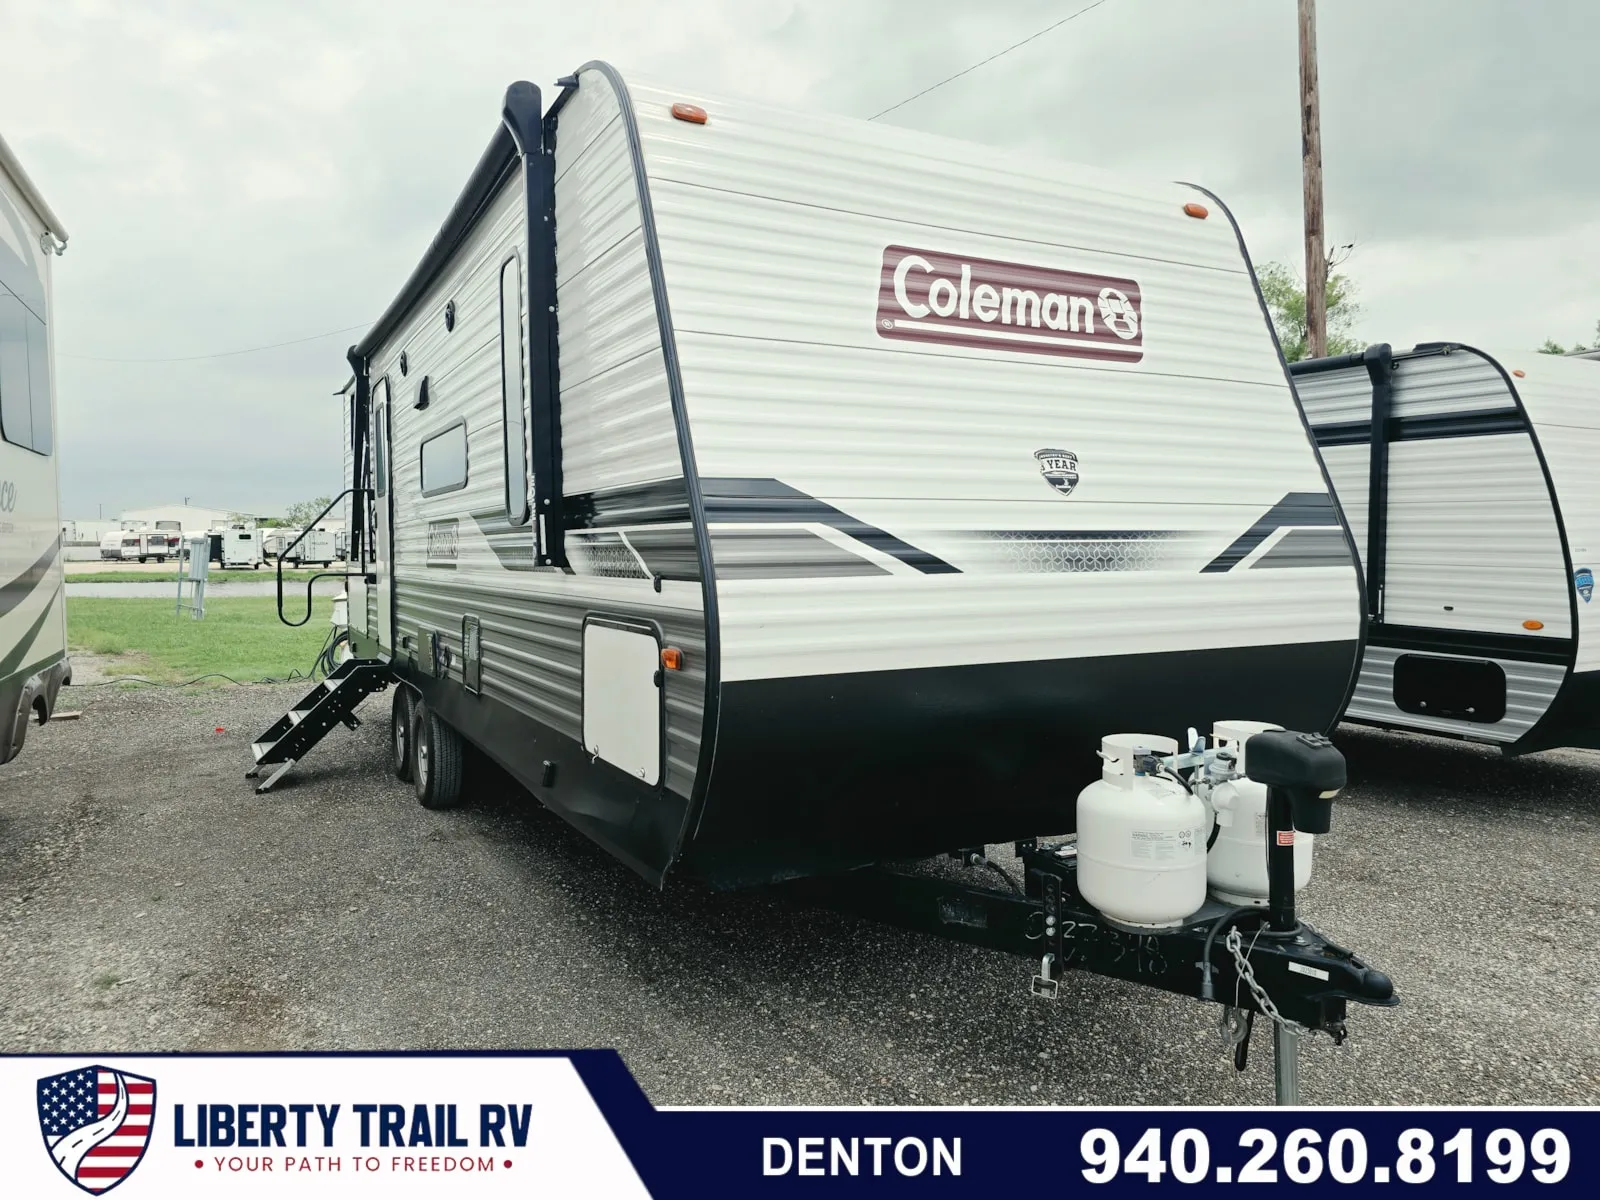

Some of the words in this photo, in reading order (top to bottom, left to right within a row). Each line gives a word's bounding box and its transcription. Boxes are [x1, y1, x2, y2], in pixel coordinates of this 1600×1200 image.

[893, 255, 1095, 334] Coleman
[1046, 459, 1077, 472] YEAR
[0, 480, 18, 513] ce
